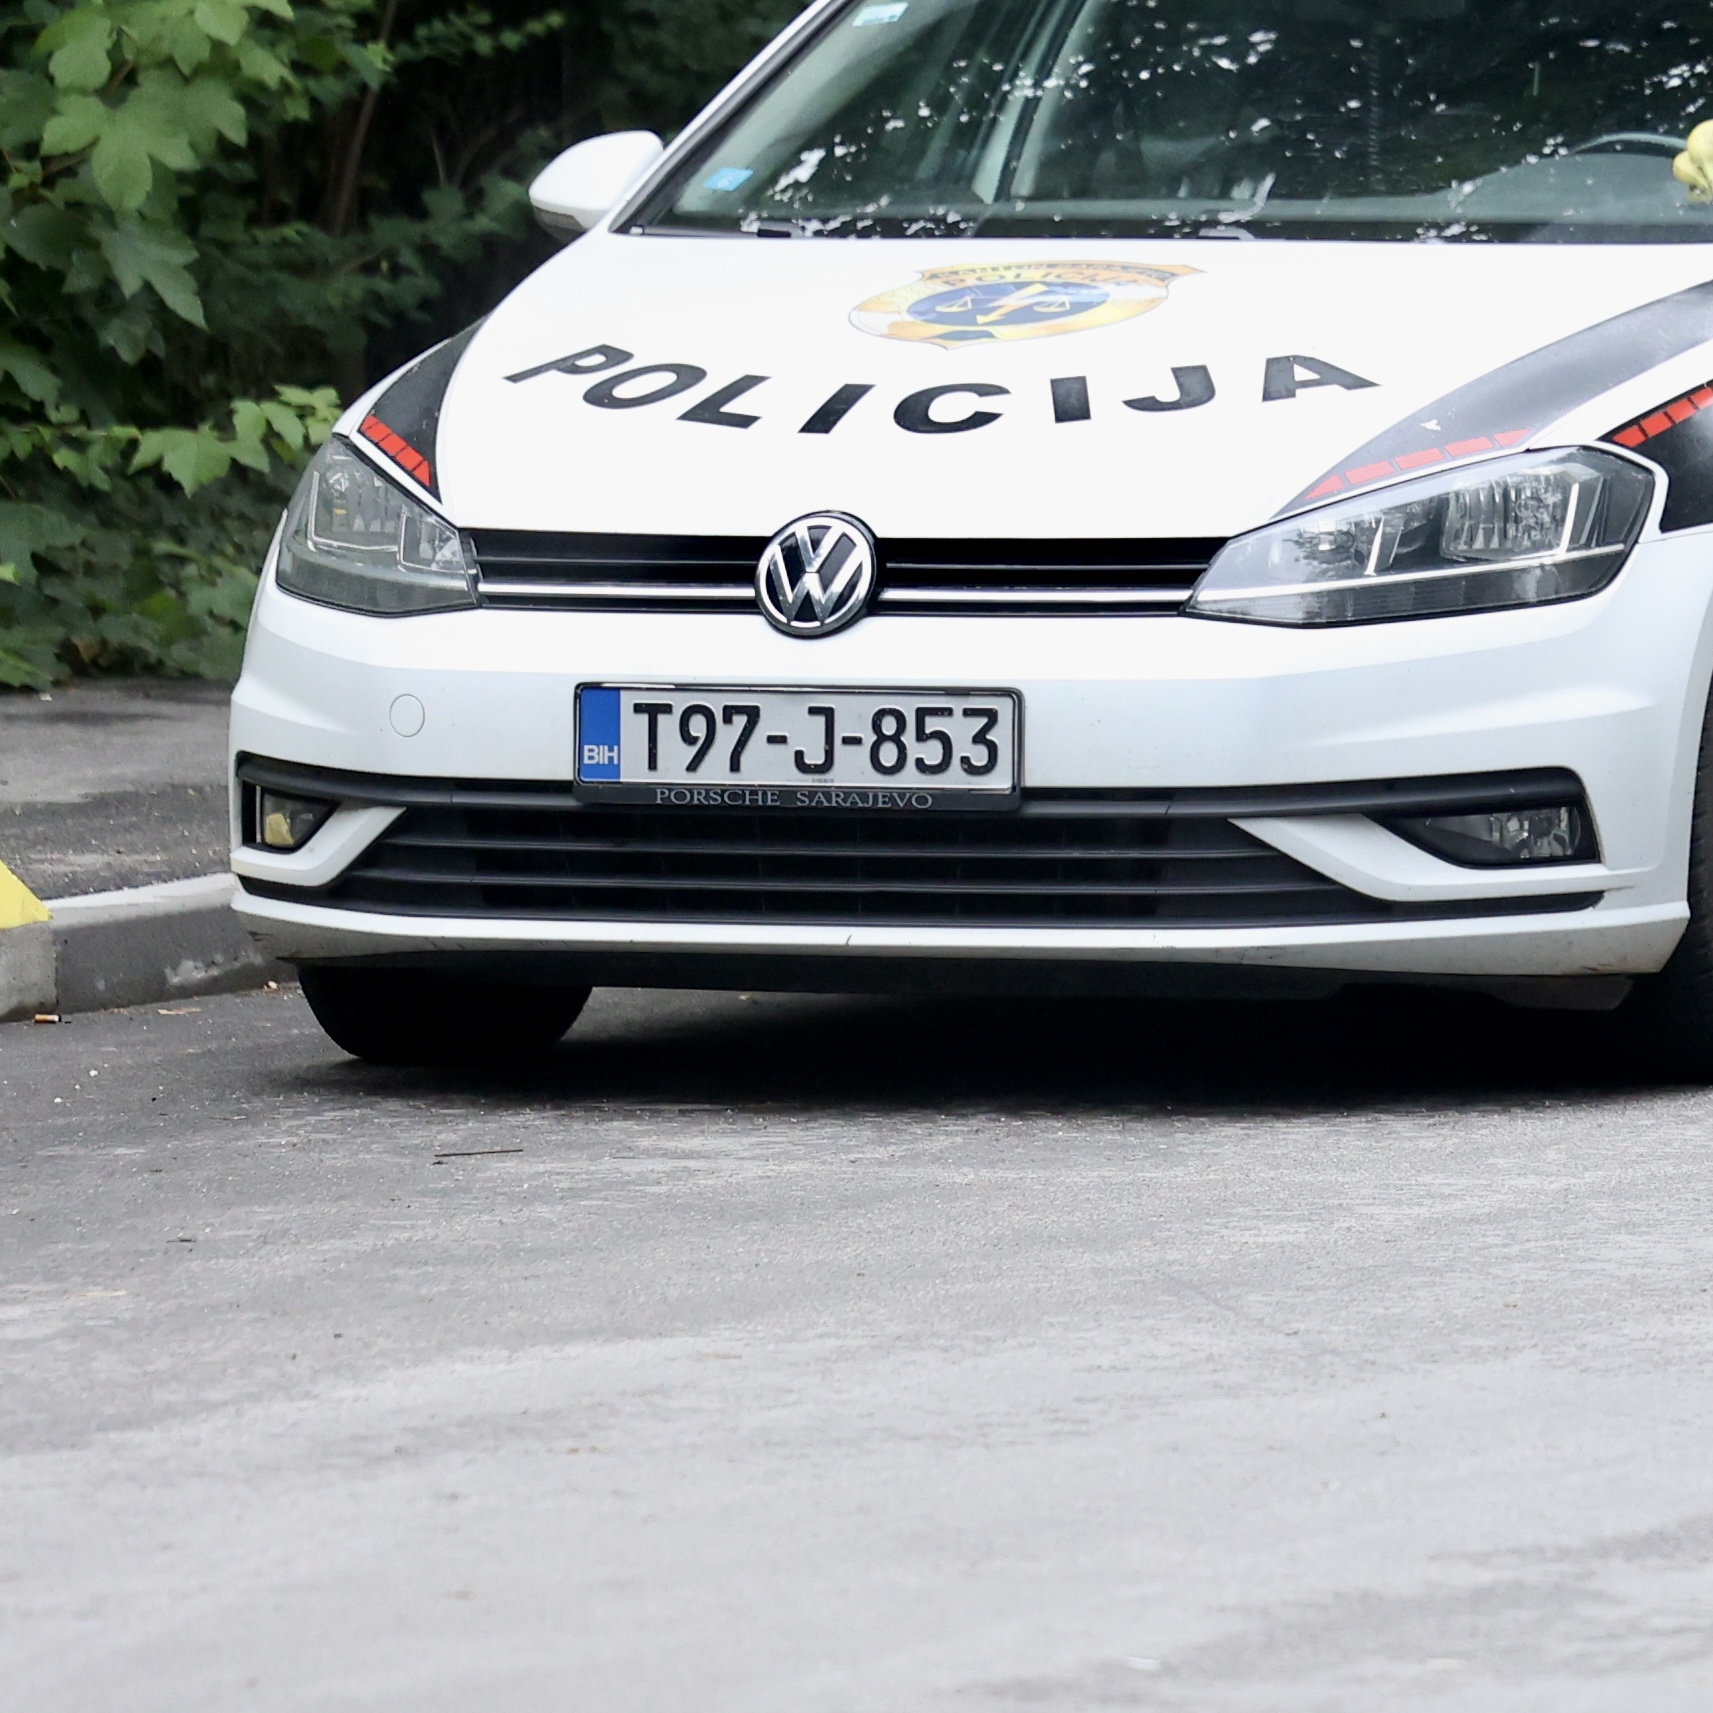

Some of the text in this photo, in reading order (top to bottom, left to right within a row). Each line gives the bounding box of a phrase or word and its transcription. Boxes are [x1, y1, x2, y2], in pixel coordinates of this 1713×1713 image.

[502, 344, 1383, 435] POLICIJA
[583, 744, 618, 766] BIH
[633, 702, 999, 776] T97-J-853
[655, 788, 933, 810] PORSCHE SARAJEVO
